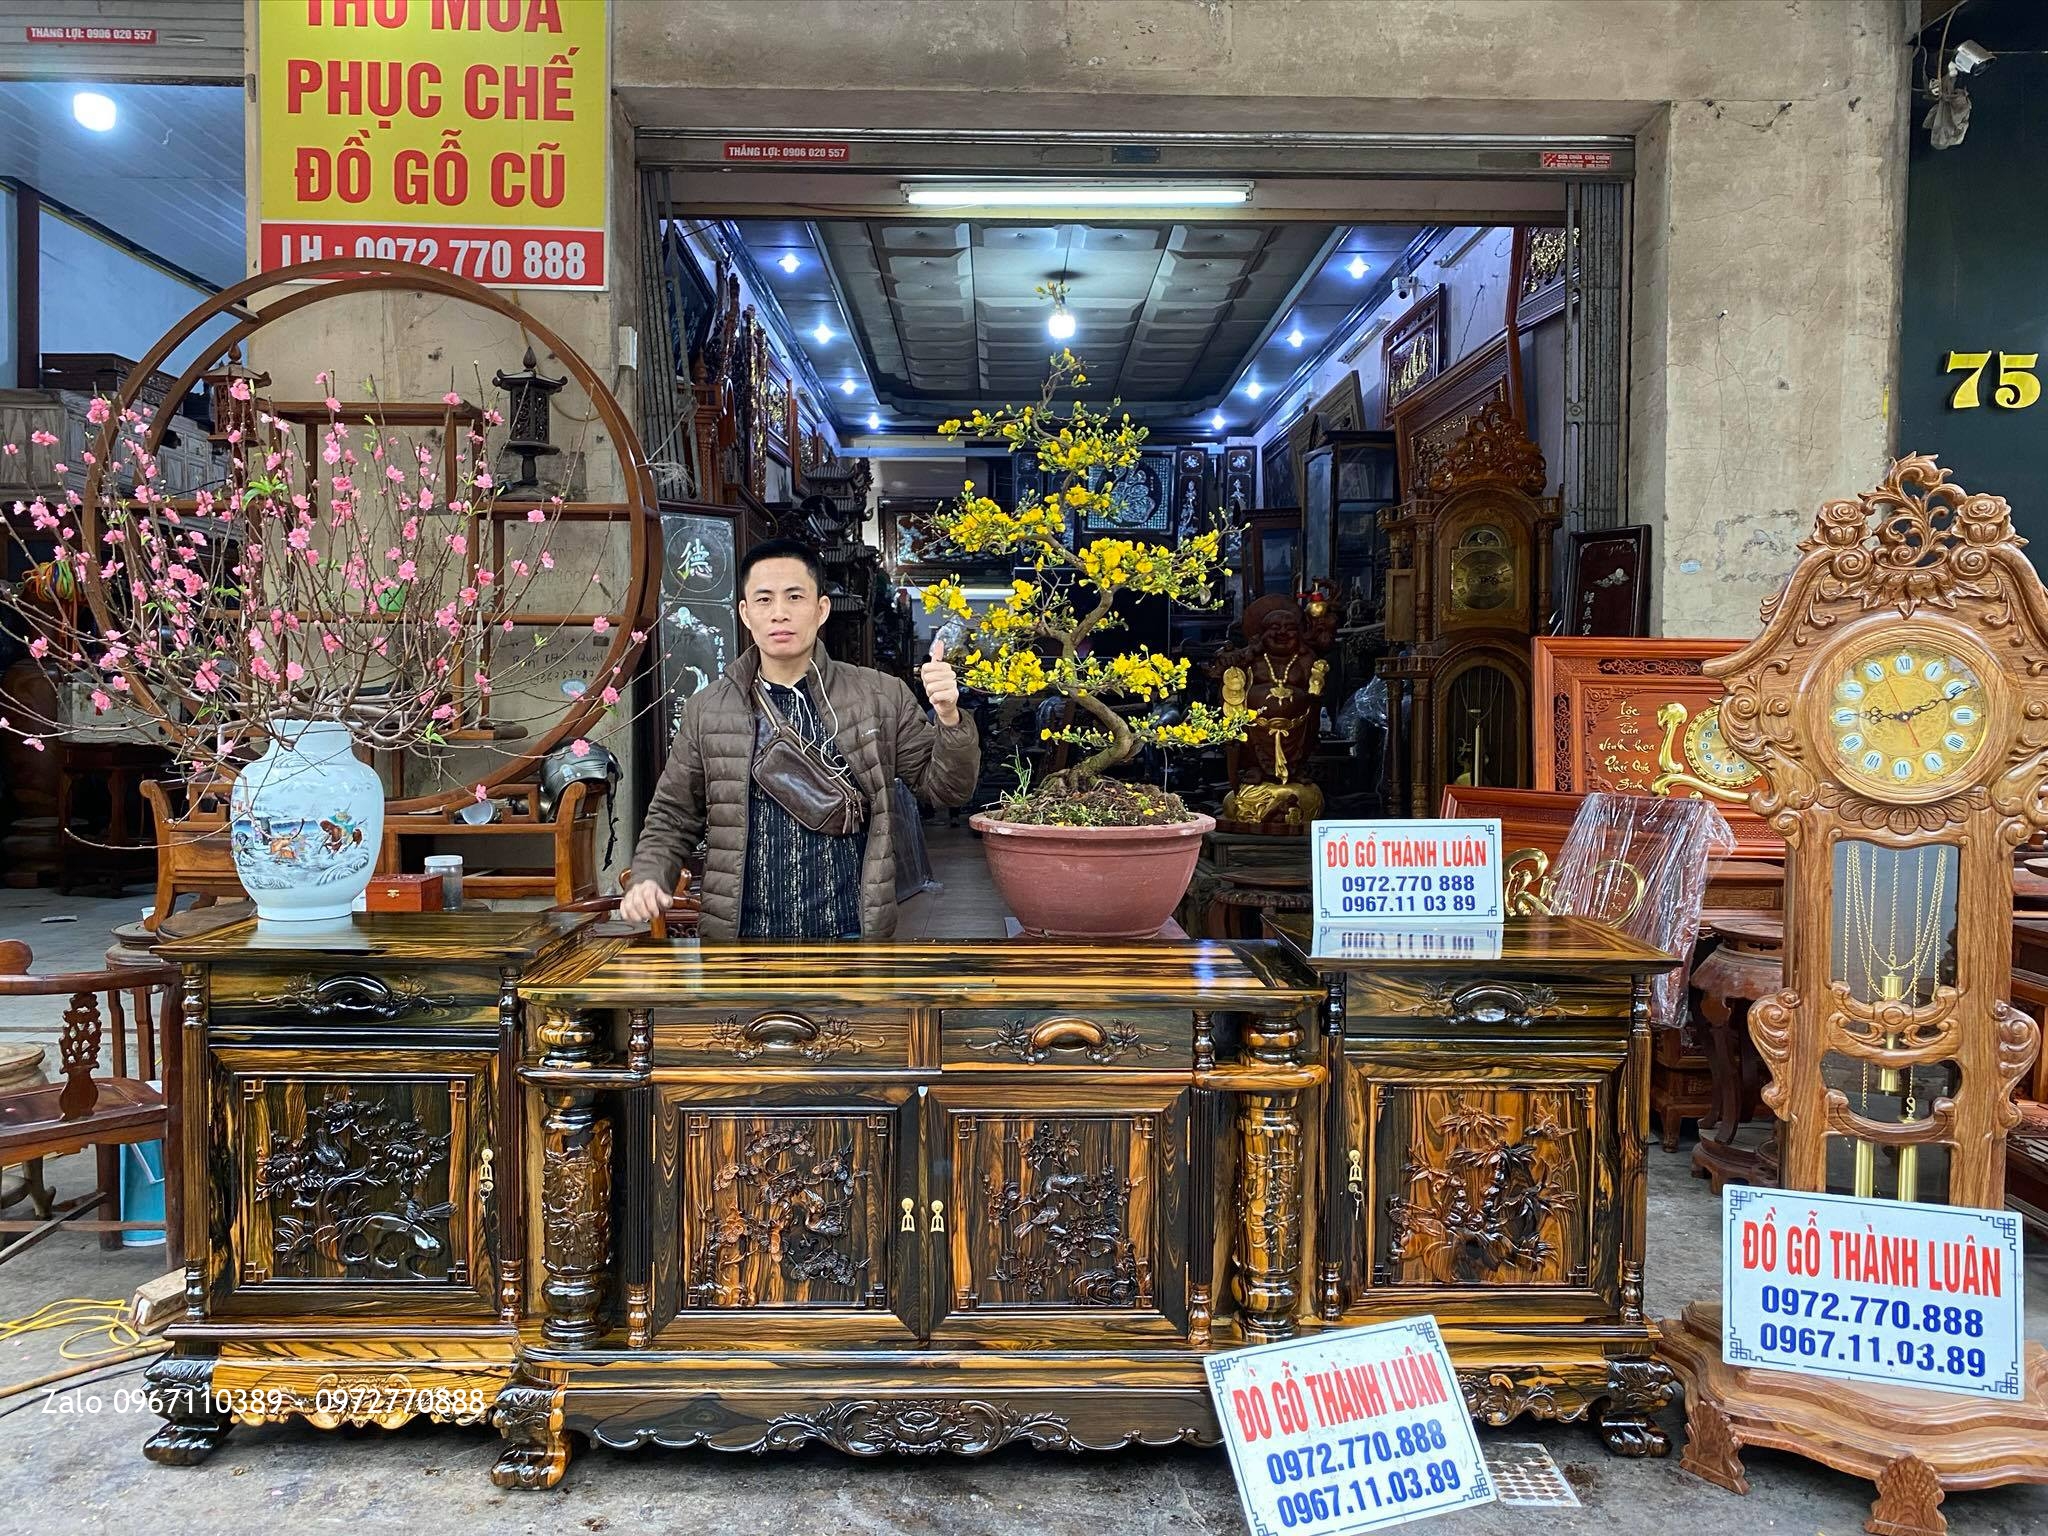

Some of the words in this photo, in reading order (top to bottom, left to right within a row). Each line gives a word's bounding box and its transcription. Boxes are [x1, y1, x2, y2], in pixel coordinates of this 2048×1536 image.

[113, 30, 132, 39] 020
[134, 31, 152, 40] 557
[287, 59, 442, 129] PHỤC
[464, 47, 581, 121] CHẾ
[294, 129, 371, 203] ĐỒ
[394, 129, 468, 206] GỖ
[491, 142, 566, 208] CŨ
[763, 146, 780, 158] LỢI:
[783, 147, 806, 157] 0906
[808, 147, 826, 157] 020
[828, 148, 846, 158] 557
[523, 241, 585, 280] 888
[1946, 350, 2041, 409] 75
[1327, 832, 1349, 868] ĐỒ
[1355, 831, 1377, 868] GỖ
[1382, 836, 1437, 867] THÀNH
[1442, 835, 1487, 867] LUÂN
[1342, 875, 1432, 893] 0972.770
[1439, 875, 1475, 891] 888
[1342, 895, 1415, 912] 0967.11
[1423, 895, 1446, 911] 03
[1453, 895, 1476, 911] 89
[1742, 1206, 1778, 1273] ĐỒ
[1787, 1210, 1820, 1277] GỖ
[1829, 1224, 1919, 1288] THÀNH
[1928, 1235, 2002, 1298] LUÂN
[1761, 1285, 1984, 1338] 0972.770.888
[1760, 1323, 1986, 1378] 0967.11.03.89
[1270, 1360, 1310, 1435] GỖ
[1304, 1362, 1388, 1428] THÀNH
[1381, 1346, 1448, 1412] LUÂN
[1266, 1418, 1447, 1485] 0972.770.888
[1277, 1459, 1461, 1528] 0967.11.03.89
